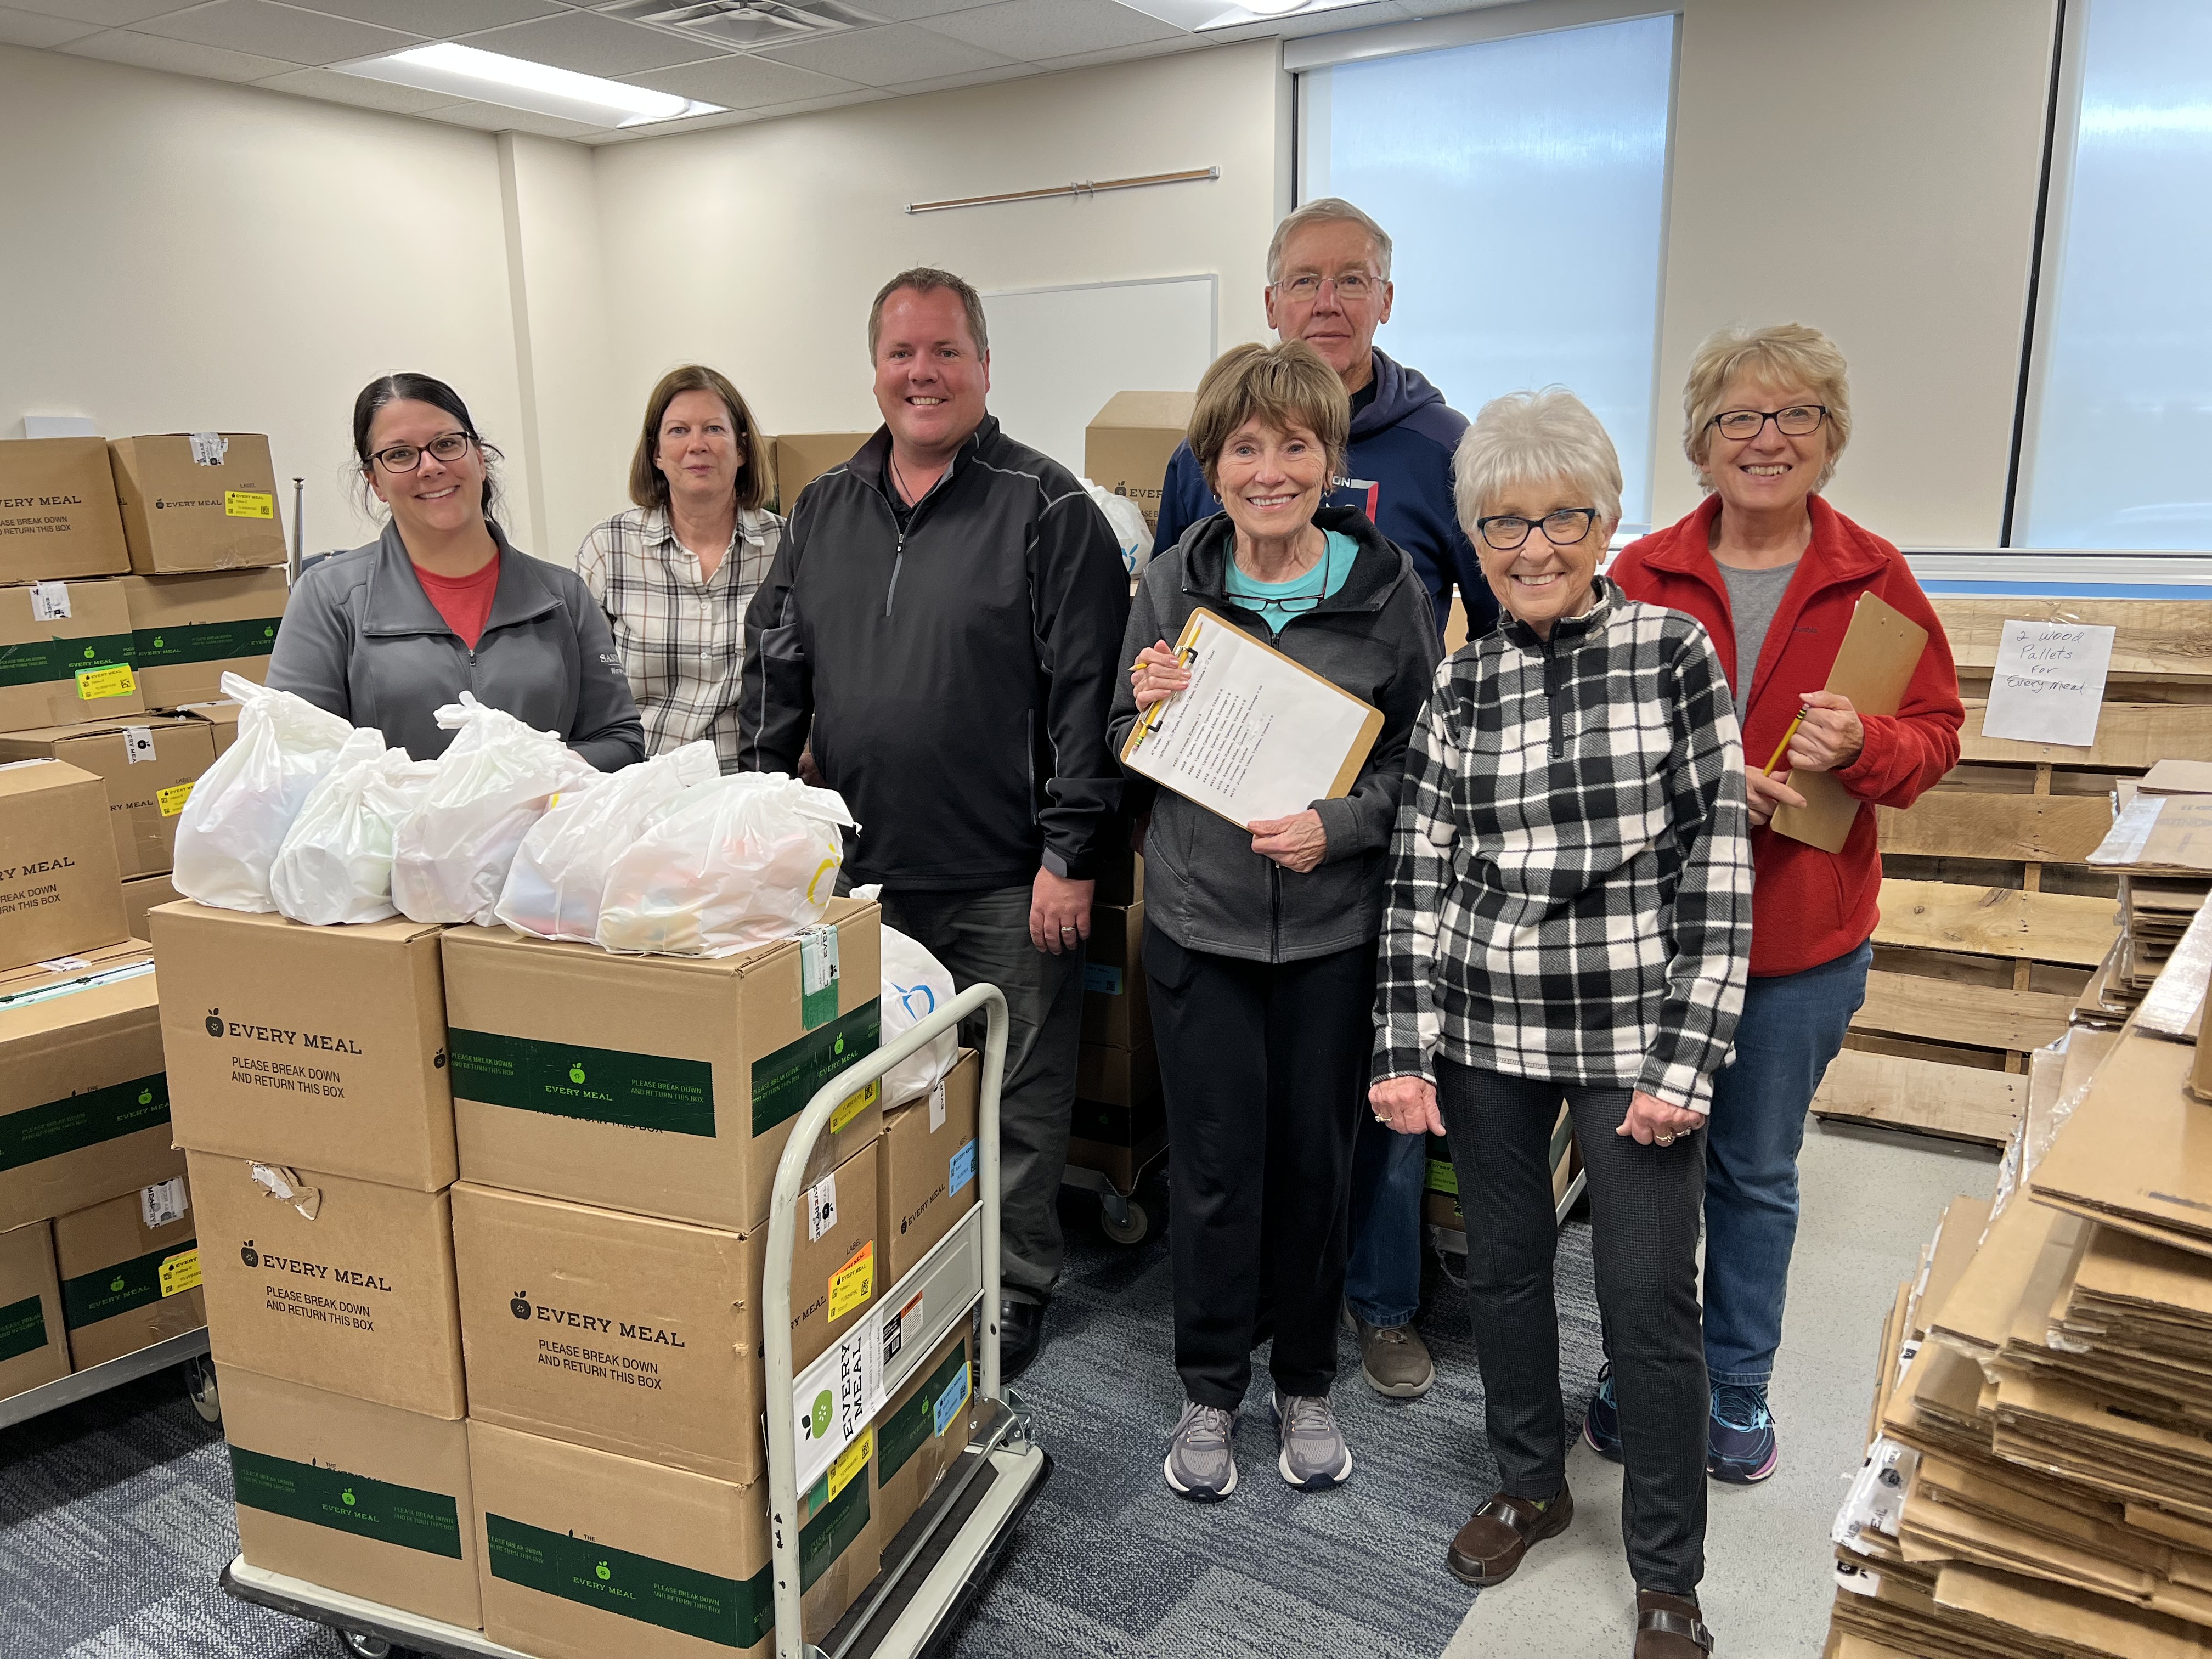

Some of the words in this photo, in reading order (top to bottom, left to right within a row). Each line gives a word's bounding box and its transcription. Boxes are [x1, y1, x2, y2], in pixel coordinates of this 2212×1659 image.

[0, 498, 33, 507] ERY
[40, 495, 82, 505] MEAL
[1130, 489, 1163, 498] EVER
[4, 526, 35, 535] RETURN
[16, 517, 42, 525] BREAK
[2017, 631, 2029, 641] 2
[2020, 644, 2073, 660] Pallets
[2032, 664, 2059, 674] For
[2007, 675, 2044, 694] Every
[126, 800, 154, 809] MEAL
[22, 857, 75, 876] MEAL
[0, 891, 25, 903] REAK
[27, 884, 57, 897] DOWN
[17, 899, 39, 910] THIS
[41, 894, 61, 905] BOX
[229, 1023, 296, 1045] EVERY
[303, 1034, 362, 1054] MEAL
[451, 1052, 472, 1062] PLEASE
[473, 1056, 493, 1065] BREAK
[494, 1059, 513, 1068] DOWN
[463, 1063, 487, 1073] RETURN
[503, 1068, 515, 1076] BOX
[818, 1060, 839, 1078] EVERY
[841, 1050, 859, 1064] MEAL
[232, 1057, 269, 1073] PLEASE
[272, 1062, 306, 1077] BREAK
[308, 1068, 340, 1083] DOWN
[770, 1074, 785, 1087] BREAK
[786, 1066, 800, 1079] DOWN
[232, 1071, 252, 1085] AND
[255, 1075, 295, 1091] RETURN
[297, 1081, 320, 1096] THIS
[323, 1086, 345, 1098] BOX
[545, 1085, 580, 1097] EVERY
[583, 1090, 613, 1101] MEAL
[631, 1079, 656, 1088] PLEASE
[657, 1082, 680, 1091] BREAK
[681, 1085, 702, 1094] DOWN
[630, 1087, 645, 1096] AND
[646, 1090, 673, 1099] RETURN
[674, 1093, 690, 1102] THIS
[690, 1095, 704, 1103] BOX
[117, 1109, 148, 1121] EVERY
[150, 1102, 171, 1113] MEA
[908, 1200, 929, 1227] EVERY
[929, 1183, 946, 1204] MEAL
[847, 1238, 861, 1255] LABEL
[176, 1257, 198, 1268] EVERY
[263, 1255, 328, 1279] EVERY
[334, 1269, 392, 1292] MEAL
[841, 1269, 855, 1282] EVERY
[856, 1264, 866, 1274] MEAL
[89, 1294, 121, 1310] EVERY
[123, 1285, 150, 1299] MEAL
[266, 1285, 302, 1303] PLEASE
[304, 1294, 337, 1310] BREAK
[339, 1301, 370, 1317] DOWN
[266, 1299, 286, 1312] AND
[289, 1304, 326, 1322] RETURN
[328, 1313, 351, 1327] THIS
[353, 1318, 374, 1331] BOX
[803, 1295, 826, 1321] MEAL
[537, 1306, 612, 1333] EVERY
[619, 1323, 685, 1348] MEAL
[539, 1339, 580, 1358] PLEASE
[583, 1348, 620, 1367] BREAK
[622, 1358, 658, 1375] DOWN
[538, 1354, 561, 1368] AND
[563, 1359, 607, 1378] RETURN
[610, 1369, 635, 1385] THIS
[637, 1376, 662, 1390] BOX
[853, 1336, 864, 1421] MEAL
[841, 1344, 854, 1441] EVERY
[322, 1504, 352, 1517] EVERY
[354, 1511, 380, 1523] MEAL
[394, 1506, 415, 1516] PLEASE
[416, 1511, 435, 1521] BREAK
[488, 1534, 505, 1545] LEASE
[506, 1540, 524, 1551] BREAK
[524, 1546, 543, 1557] DOWN
[583, 1534, 596, 1542] THE
[573, 1576, 606, 1592] EVERY
[608, 1586, 636, 1600] MEAL
[653, 1582, 677, 1596] PLEASE
[678, 1589, 699, 1601] BREAK
[699, 1595, 720, 1606] DOWN
[667, 1593, 692, 1607] RETURN
[708, 1605, 721, 1615] BOX
